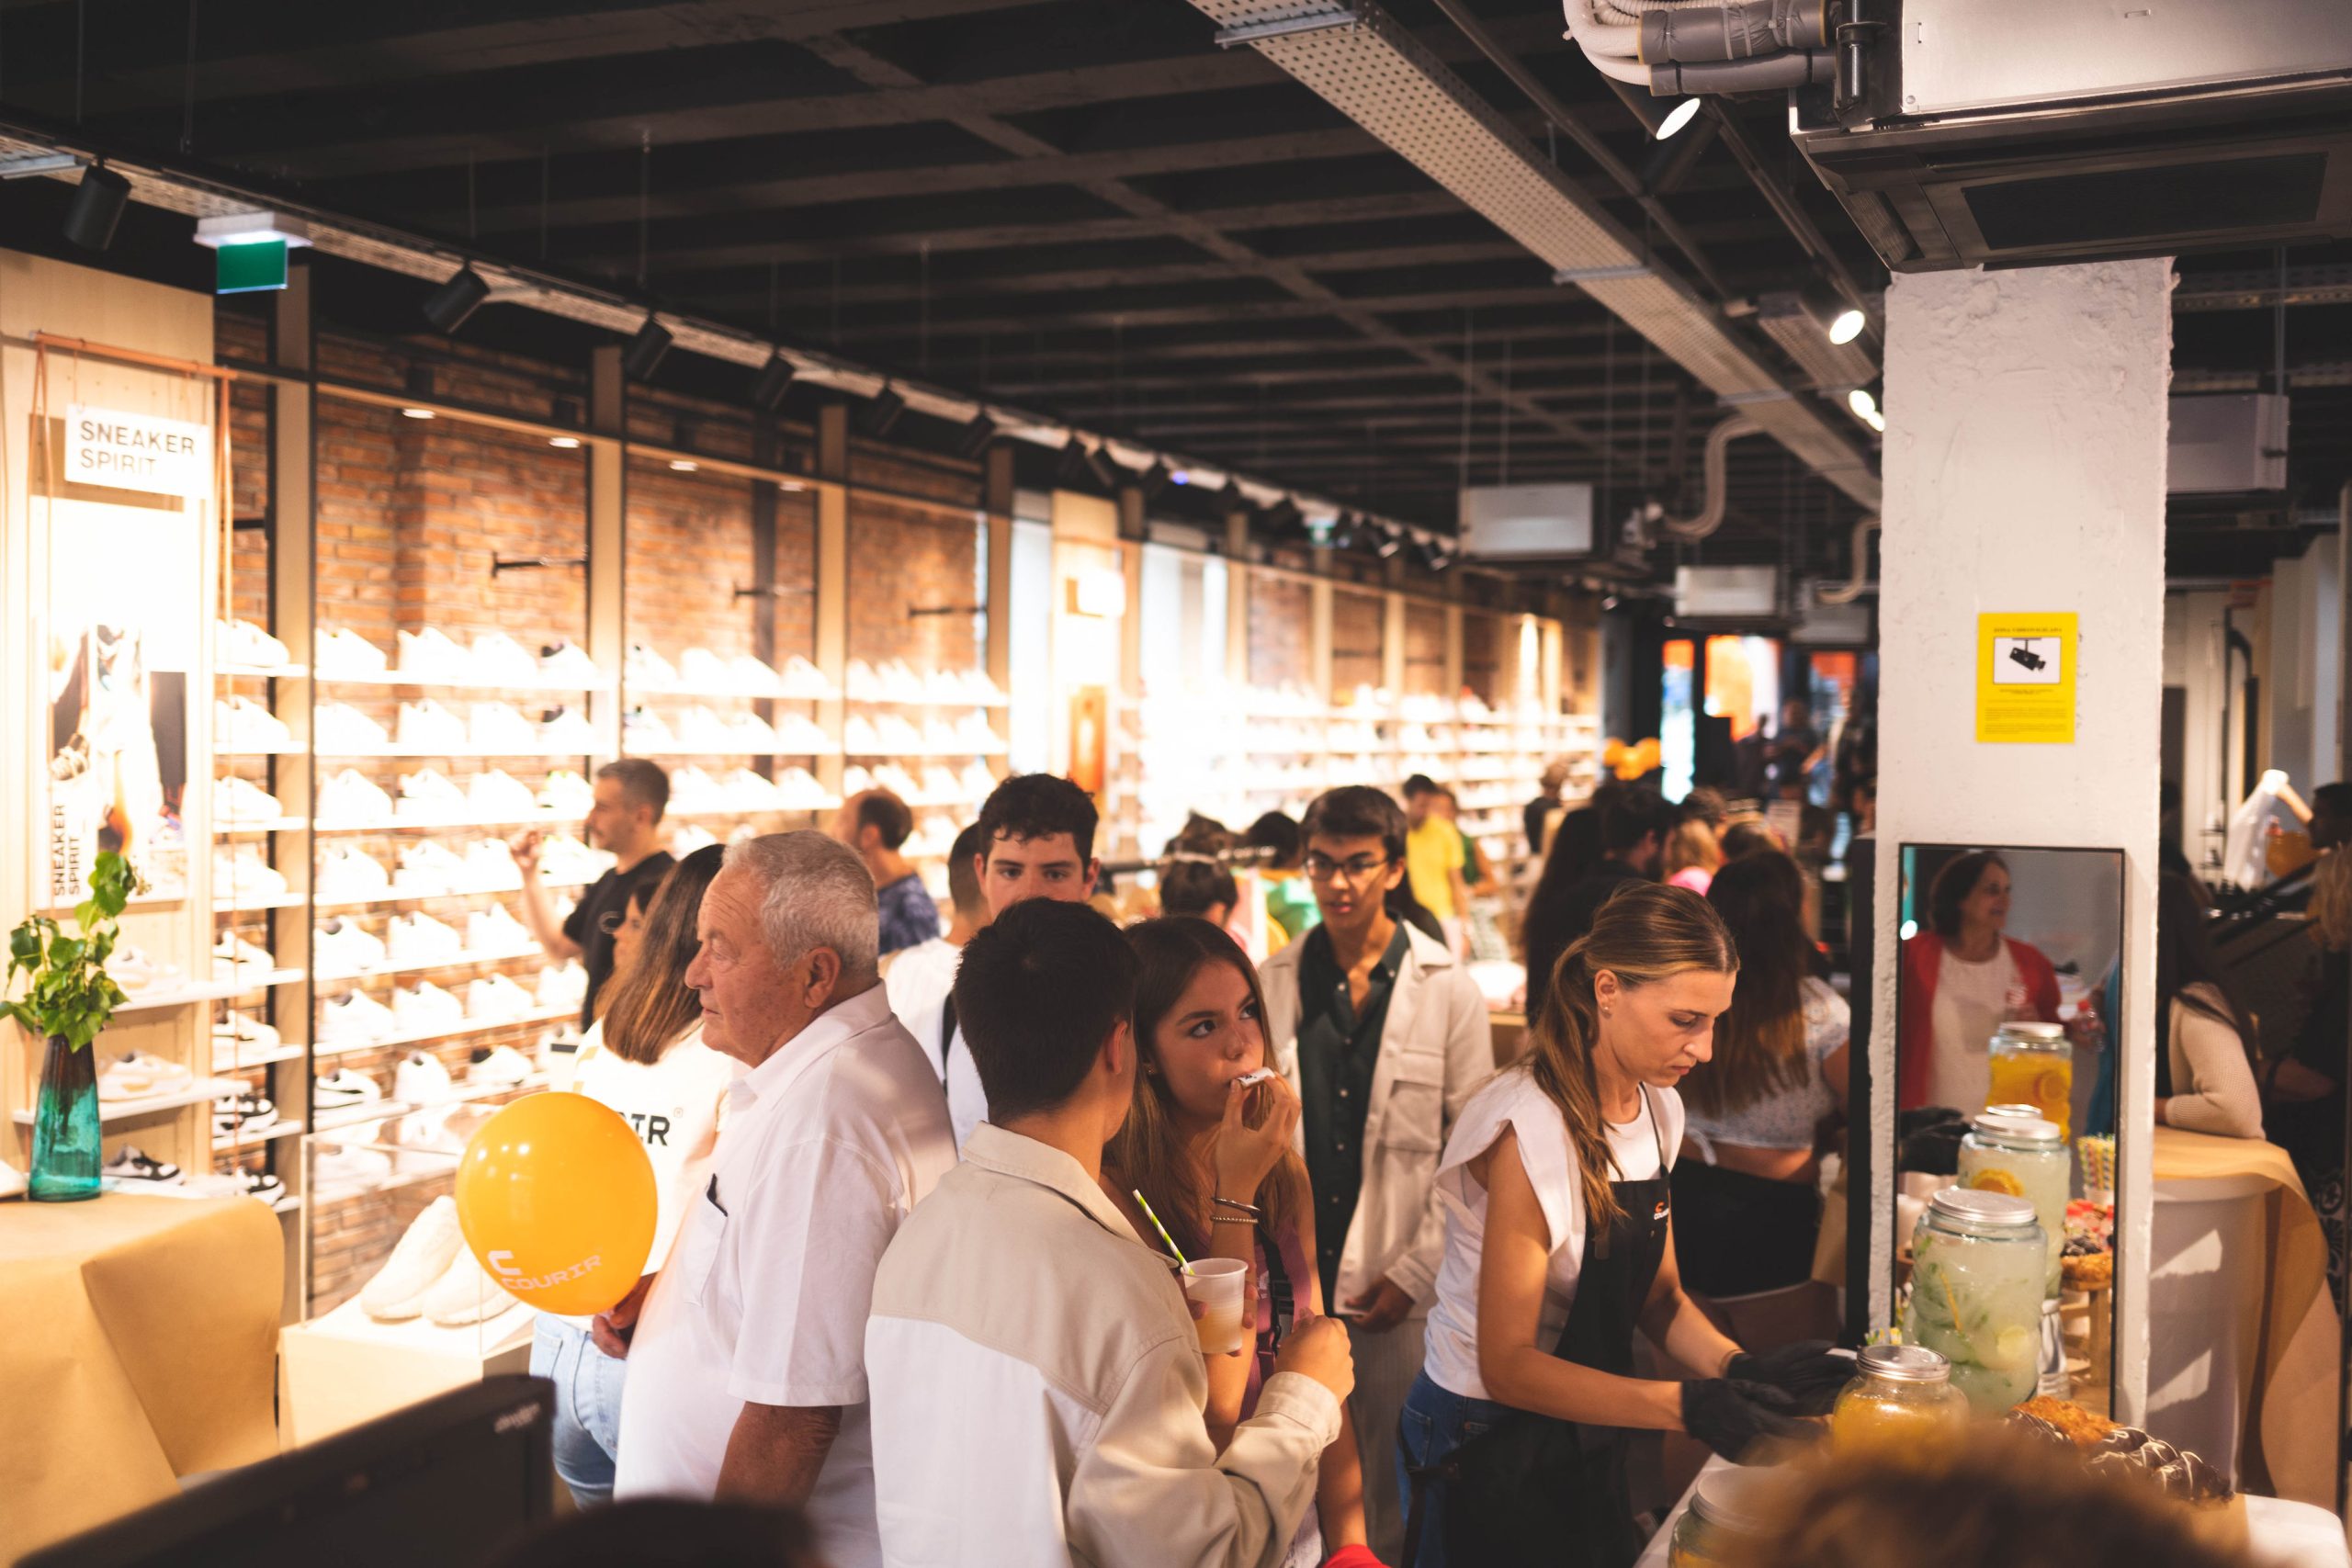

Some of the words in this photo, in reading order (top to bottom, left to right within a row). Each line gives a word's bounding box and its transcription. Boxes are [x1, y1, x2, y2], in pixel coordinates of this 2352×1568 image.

[81, 421, 195, 455] SNEAKER
[81, 448, 156, 475] SPIRIT
[53, 805, 65, 897] SNEAKER
[69, 837, 80, 895] SPIRIT
[501, 1254, 603, 1290] COURIR
